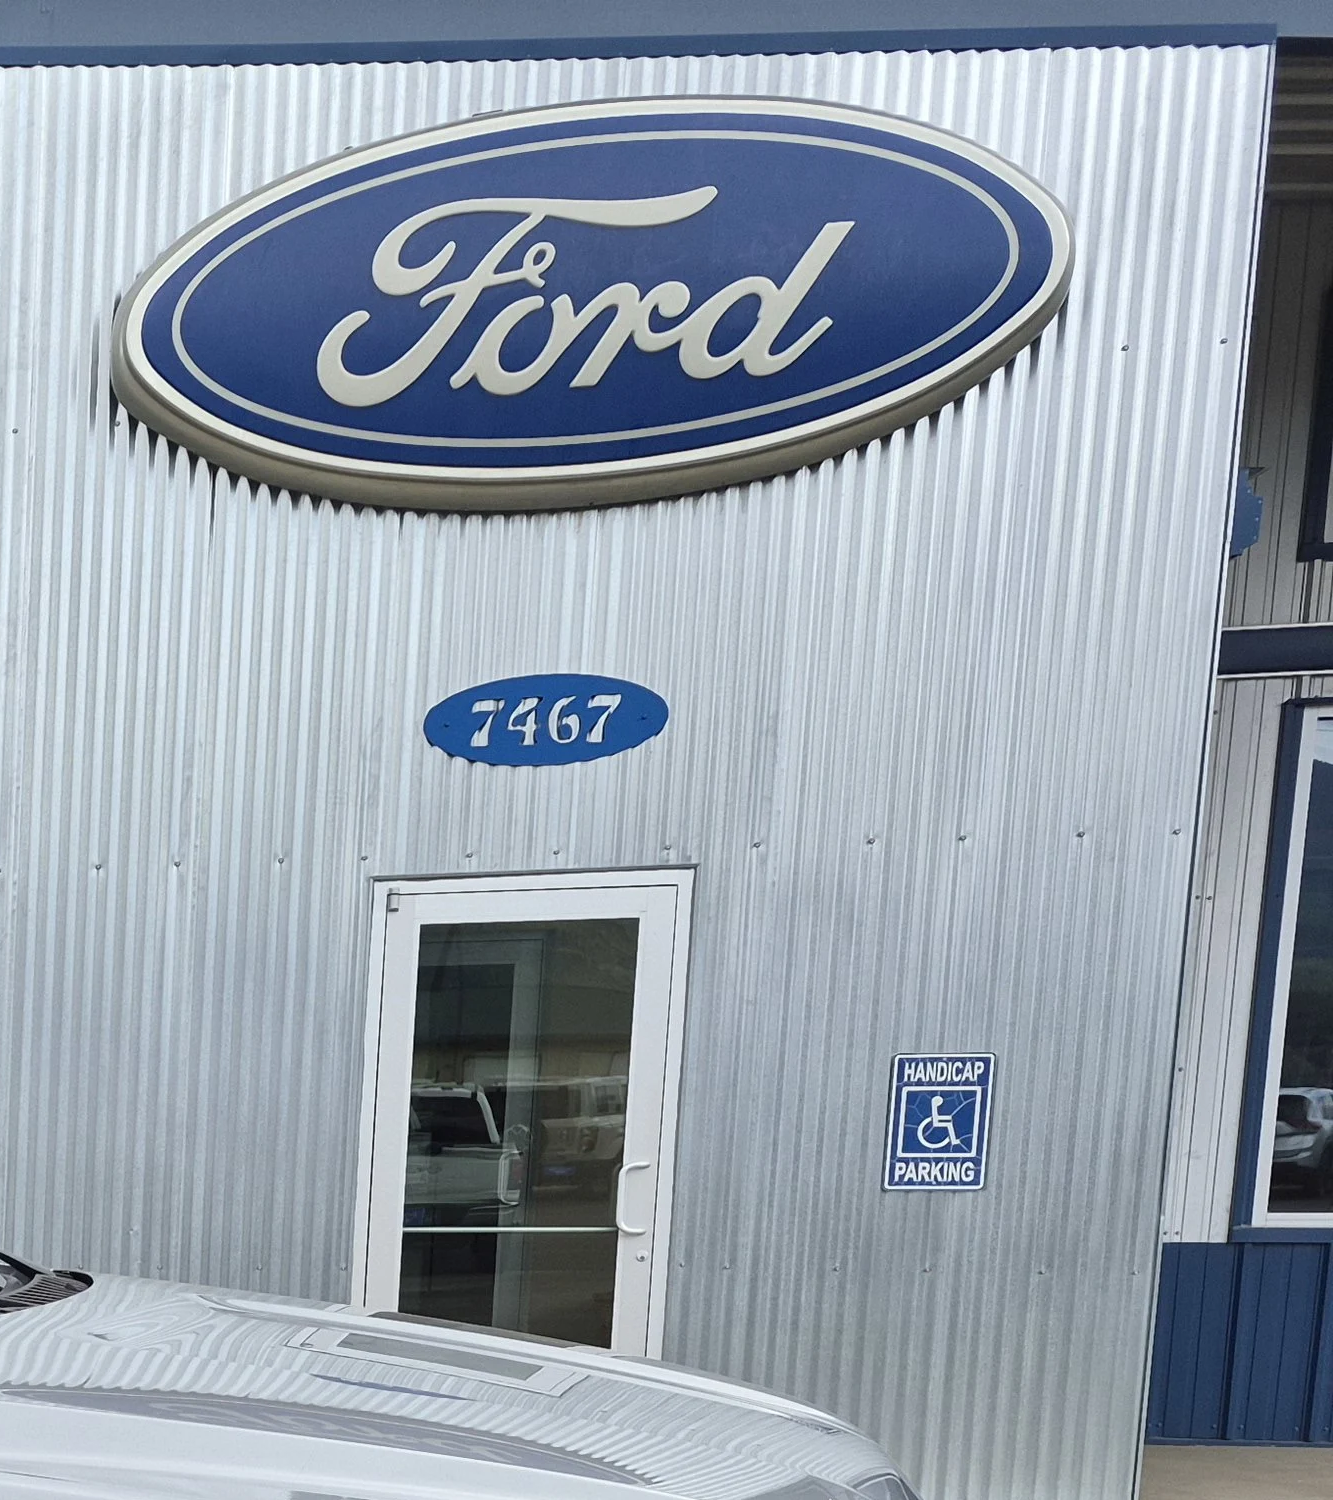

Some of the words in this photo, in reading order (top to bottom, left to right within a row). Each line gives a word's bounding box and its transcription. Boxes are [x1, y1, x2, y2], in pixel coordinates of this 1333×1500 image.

[316, 185, 856, 407] Ford
[469, 692, 623, 747] 7467
[903, 1061, 985, 1082] HANDICAP
[893, 1161, 976, 1182] PARKING
